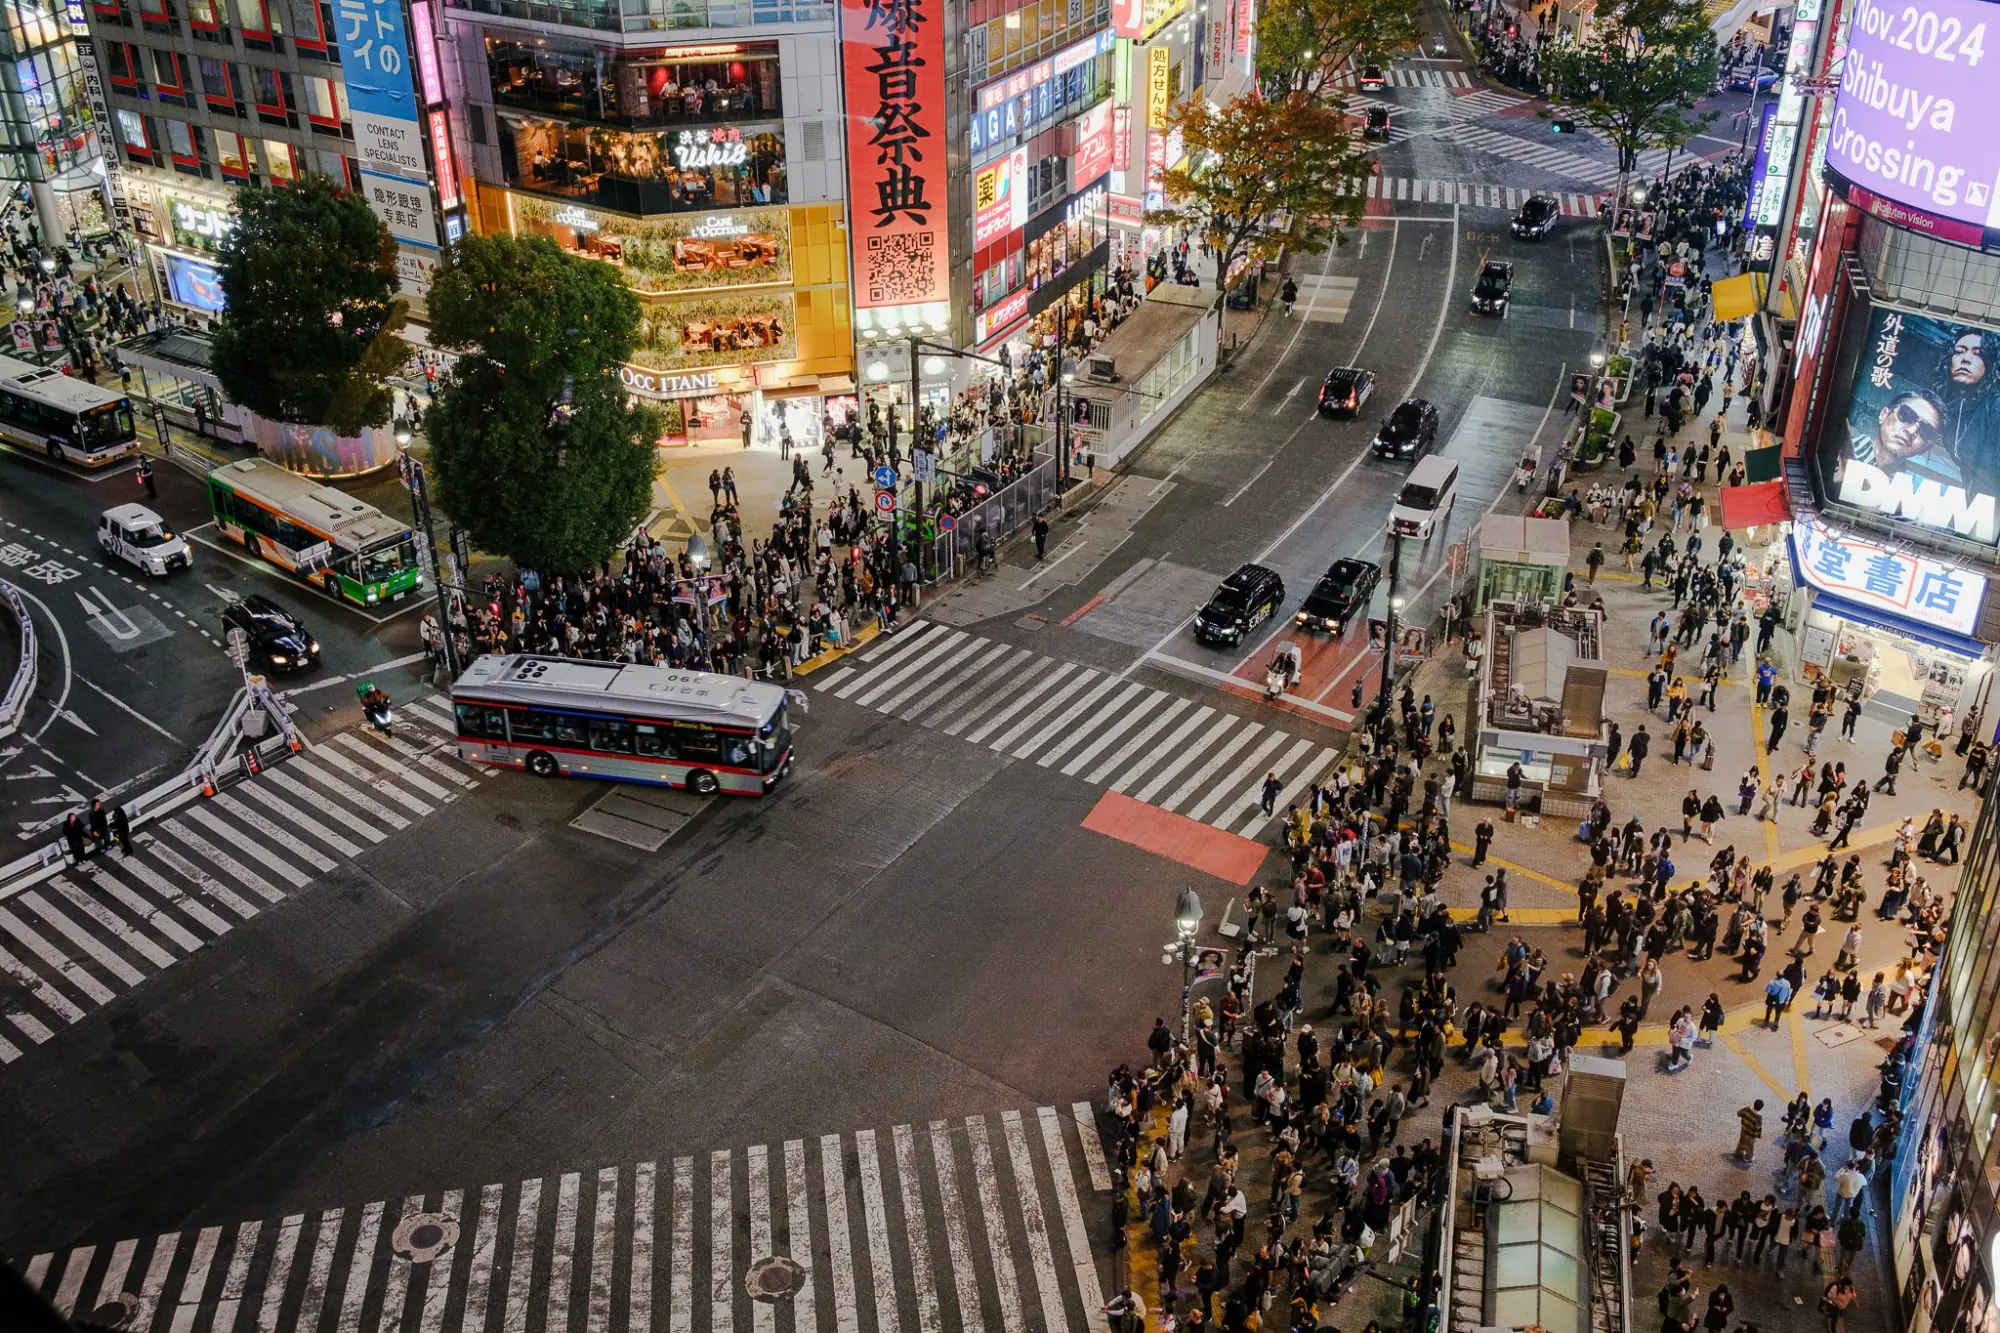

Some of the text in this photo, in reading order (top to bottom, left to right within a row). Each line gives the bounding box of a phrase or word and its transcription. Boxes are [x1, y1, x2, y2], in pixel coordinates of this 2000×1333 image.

[1100, 27, 1114, 52] 4F
[1855, 0, 1986, 67] Nov.2024
[79, 46, 92, 55] 3F
[1842, 48, 1957, 133] Shibuya
[366, 123, 405, 140] CONTACT
[679, 127, 740, 145] 渋谷 焼肉
[971, 102, 1016, 149] AGA
[1763, 113, 1777, 154] MIZUHO
[364, 147, 418, 167] SPECIALISTS
[378, 138, 400, 152] LENS
[1082, 134, 1106, 168] アコム
[1832, 107, 1965, 205] Crossing
[979, 173, 993, 208] 薬
[1066, 184, 1103, 226] LUSH
[384, 208, 418, 229] 专卖店
[977, 211, 1011, 241] サンドラッグ
[1874, 201, 1934, 229] Rakuten Vision
[1870, 312, 1905, 390] 外道の歌
[610, 366, 719, 392] OCCITANE
[1839, 459, 1998, 543] DMM
[1872, 623, 1917, 641] TAISEIDO
